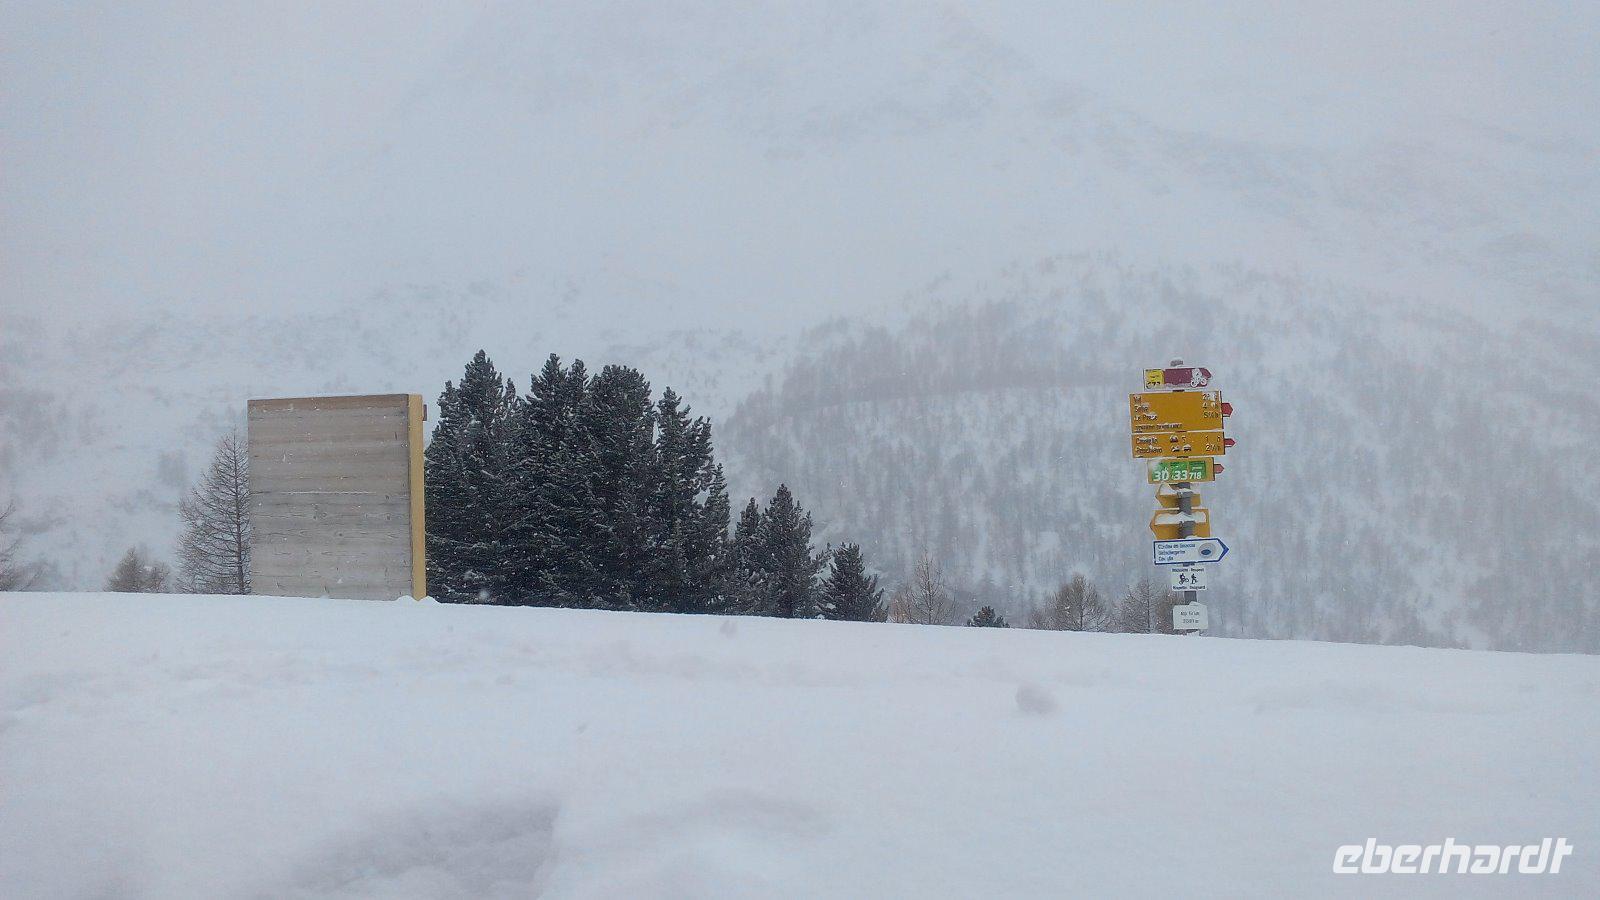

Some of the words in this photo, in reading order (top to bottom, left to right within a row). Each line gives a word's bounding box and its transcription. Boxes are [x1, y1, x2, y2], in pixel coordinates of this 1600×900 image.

[1153, 469, 1170, 481] 30
[1173, 469, 1188, 480] 33
[1189, 471, 1202, 480] 718
